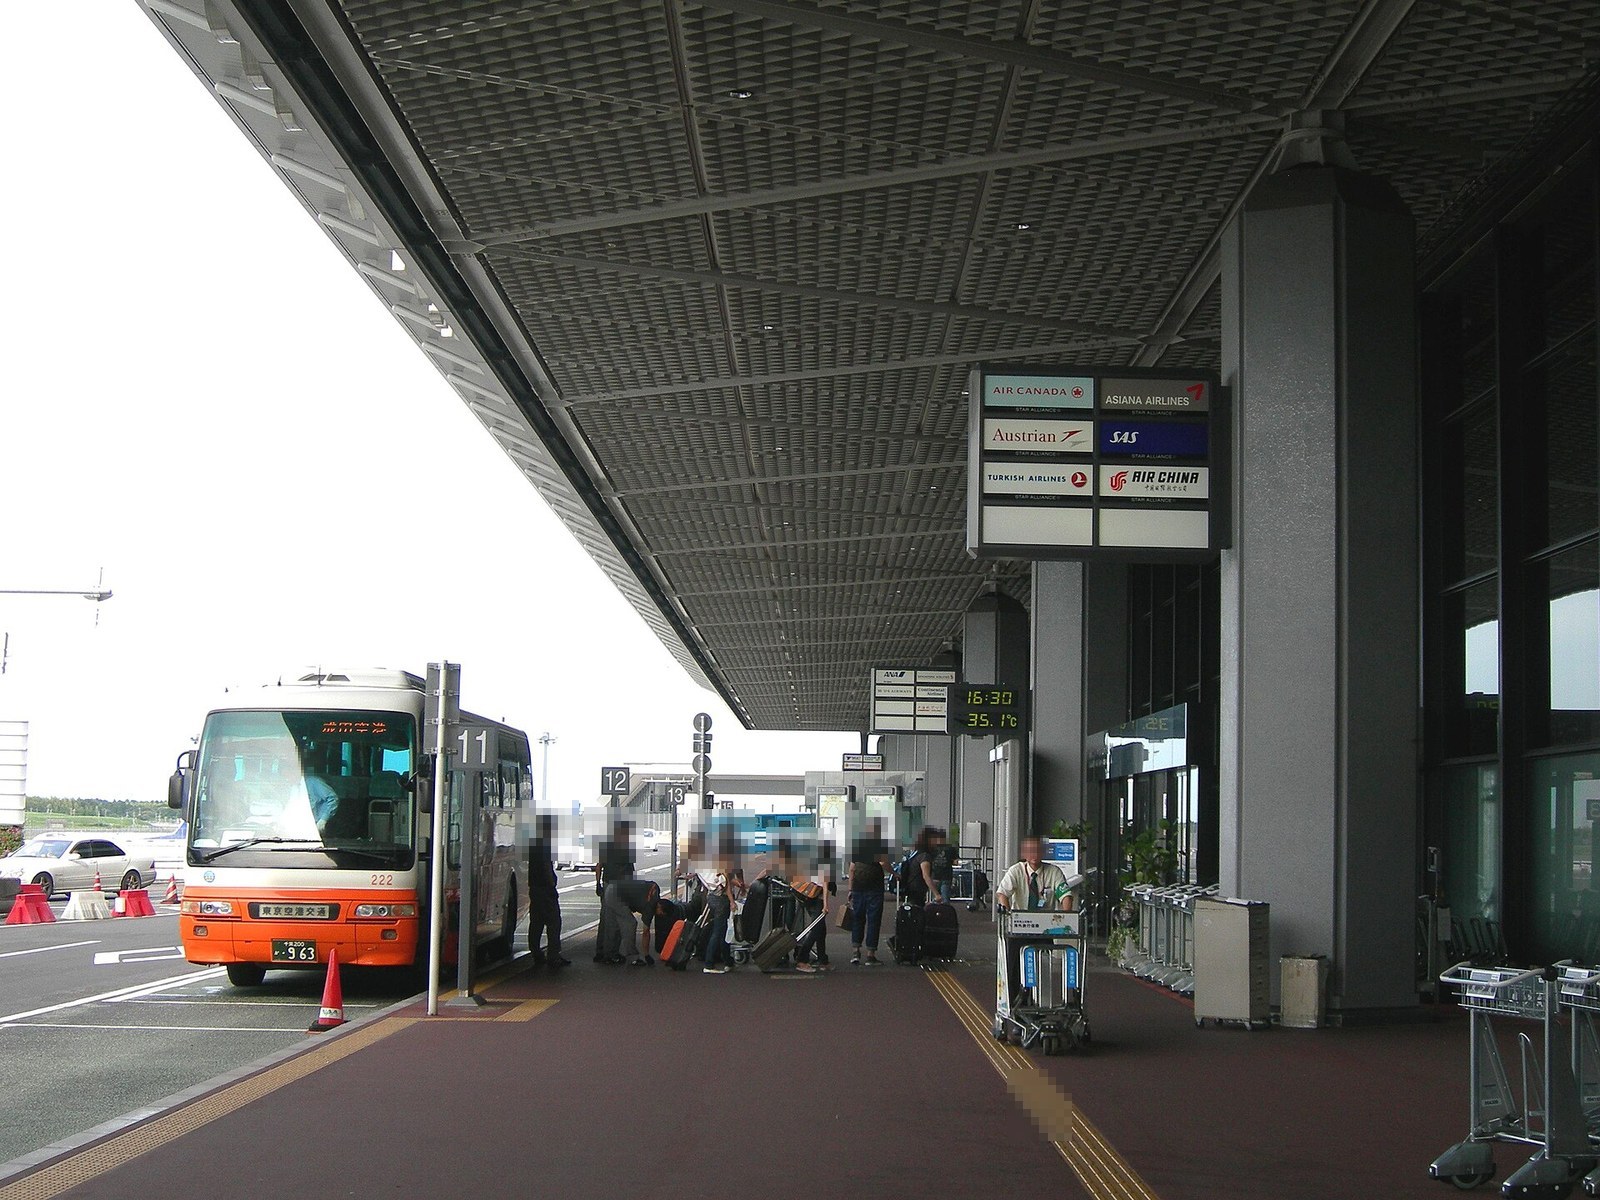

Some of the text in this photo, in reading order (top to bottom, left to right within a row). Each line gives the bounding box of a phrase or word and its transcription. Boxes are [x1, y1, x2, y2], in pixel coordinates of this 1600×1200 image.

[993, 387, 1067, 395] AIR CANADA
[1105, 395, 1190, 406] ASIANA AIRLINES
[992, 428, 1056, 443] Austrian
[1109, 431, 1139, 444] SAS
[1132, 471, 1199, 484] AIR CHINA
[967, 691, 1012, 705] 16:30
[458, 729, 487, 764] 11
[605, 770, 626, 791] 12
[668, 787, 683, 803] 13
[371, 874, 393, 886] 222
[262, 906, 326, 917] 東京空港交通
